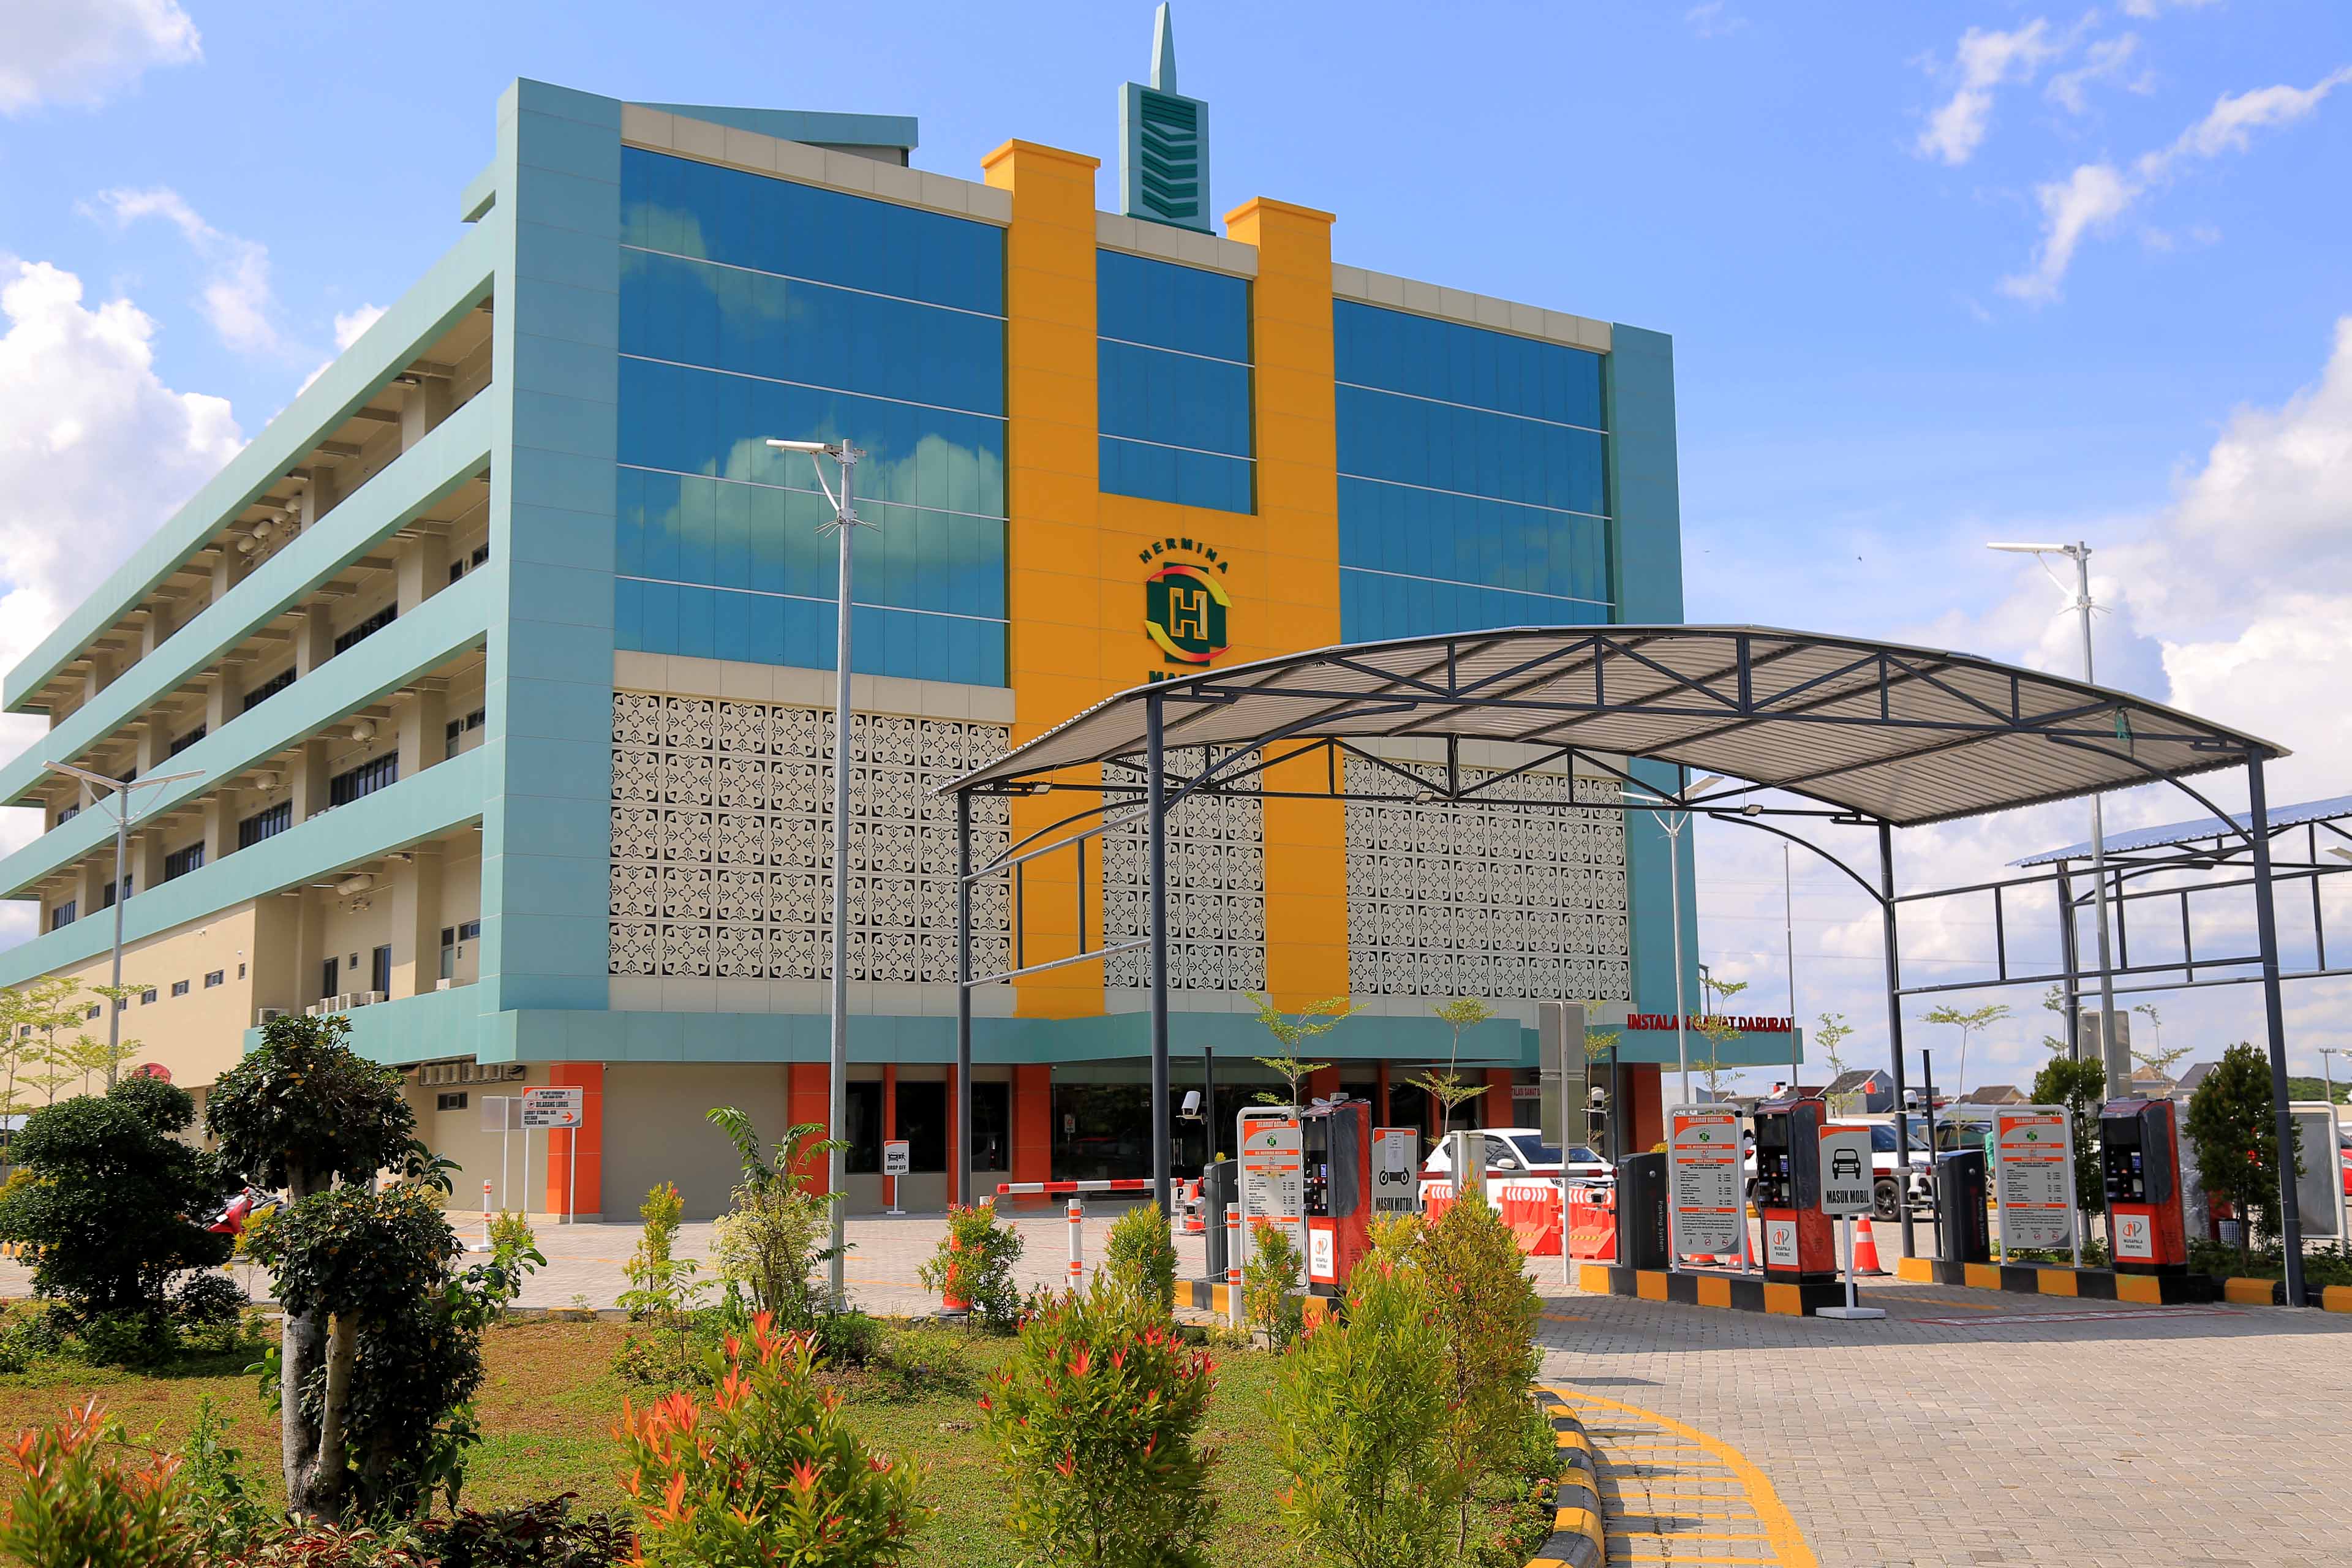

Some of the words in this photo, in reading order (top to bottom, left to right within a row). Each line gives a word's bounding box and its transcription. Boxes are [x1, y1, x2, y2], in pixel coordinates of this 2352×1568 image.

[1139, 537, 1228, 574] HERMINA
[1627, 1014, 1691, 1031] INSTALAI
[1738, 1016, 1792, 1033] DARURAT
[1177, 1188, 1184, 1199] P
[1826, 1190, 1849, 1204] MASUK
[1850, 1190, 1869, 1203] MOBIL
[1376, 1197, 1395, 1212] MASUK
[1395, 1197, 1412, 1212] MOTOR
